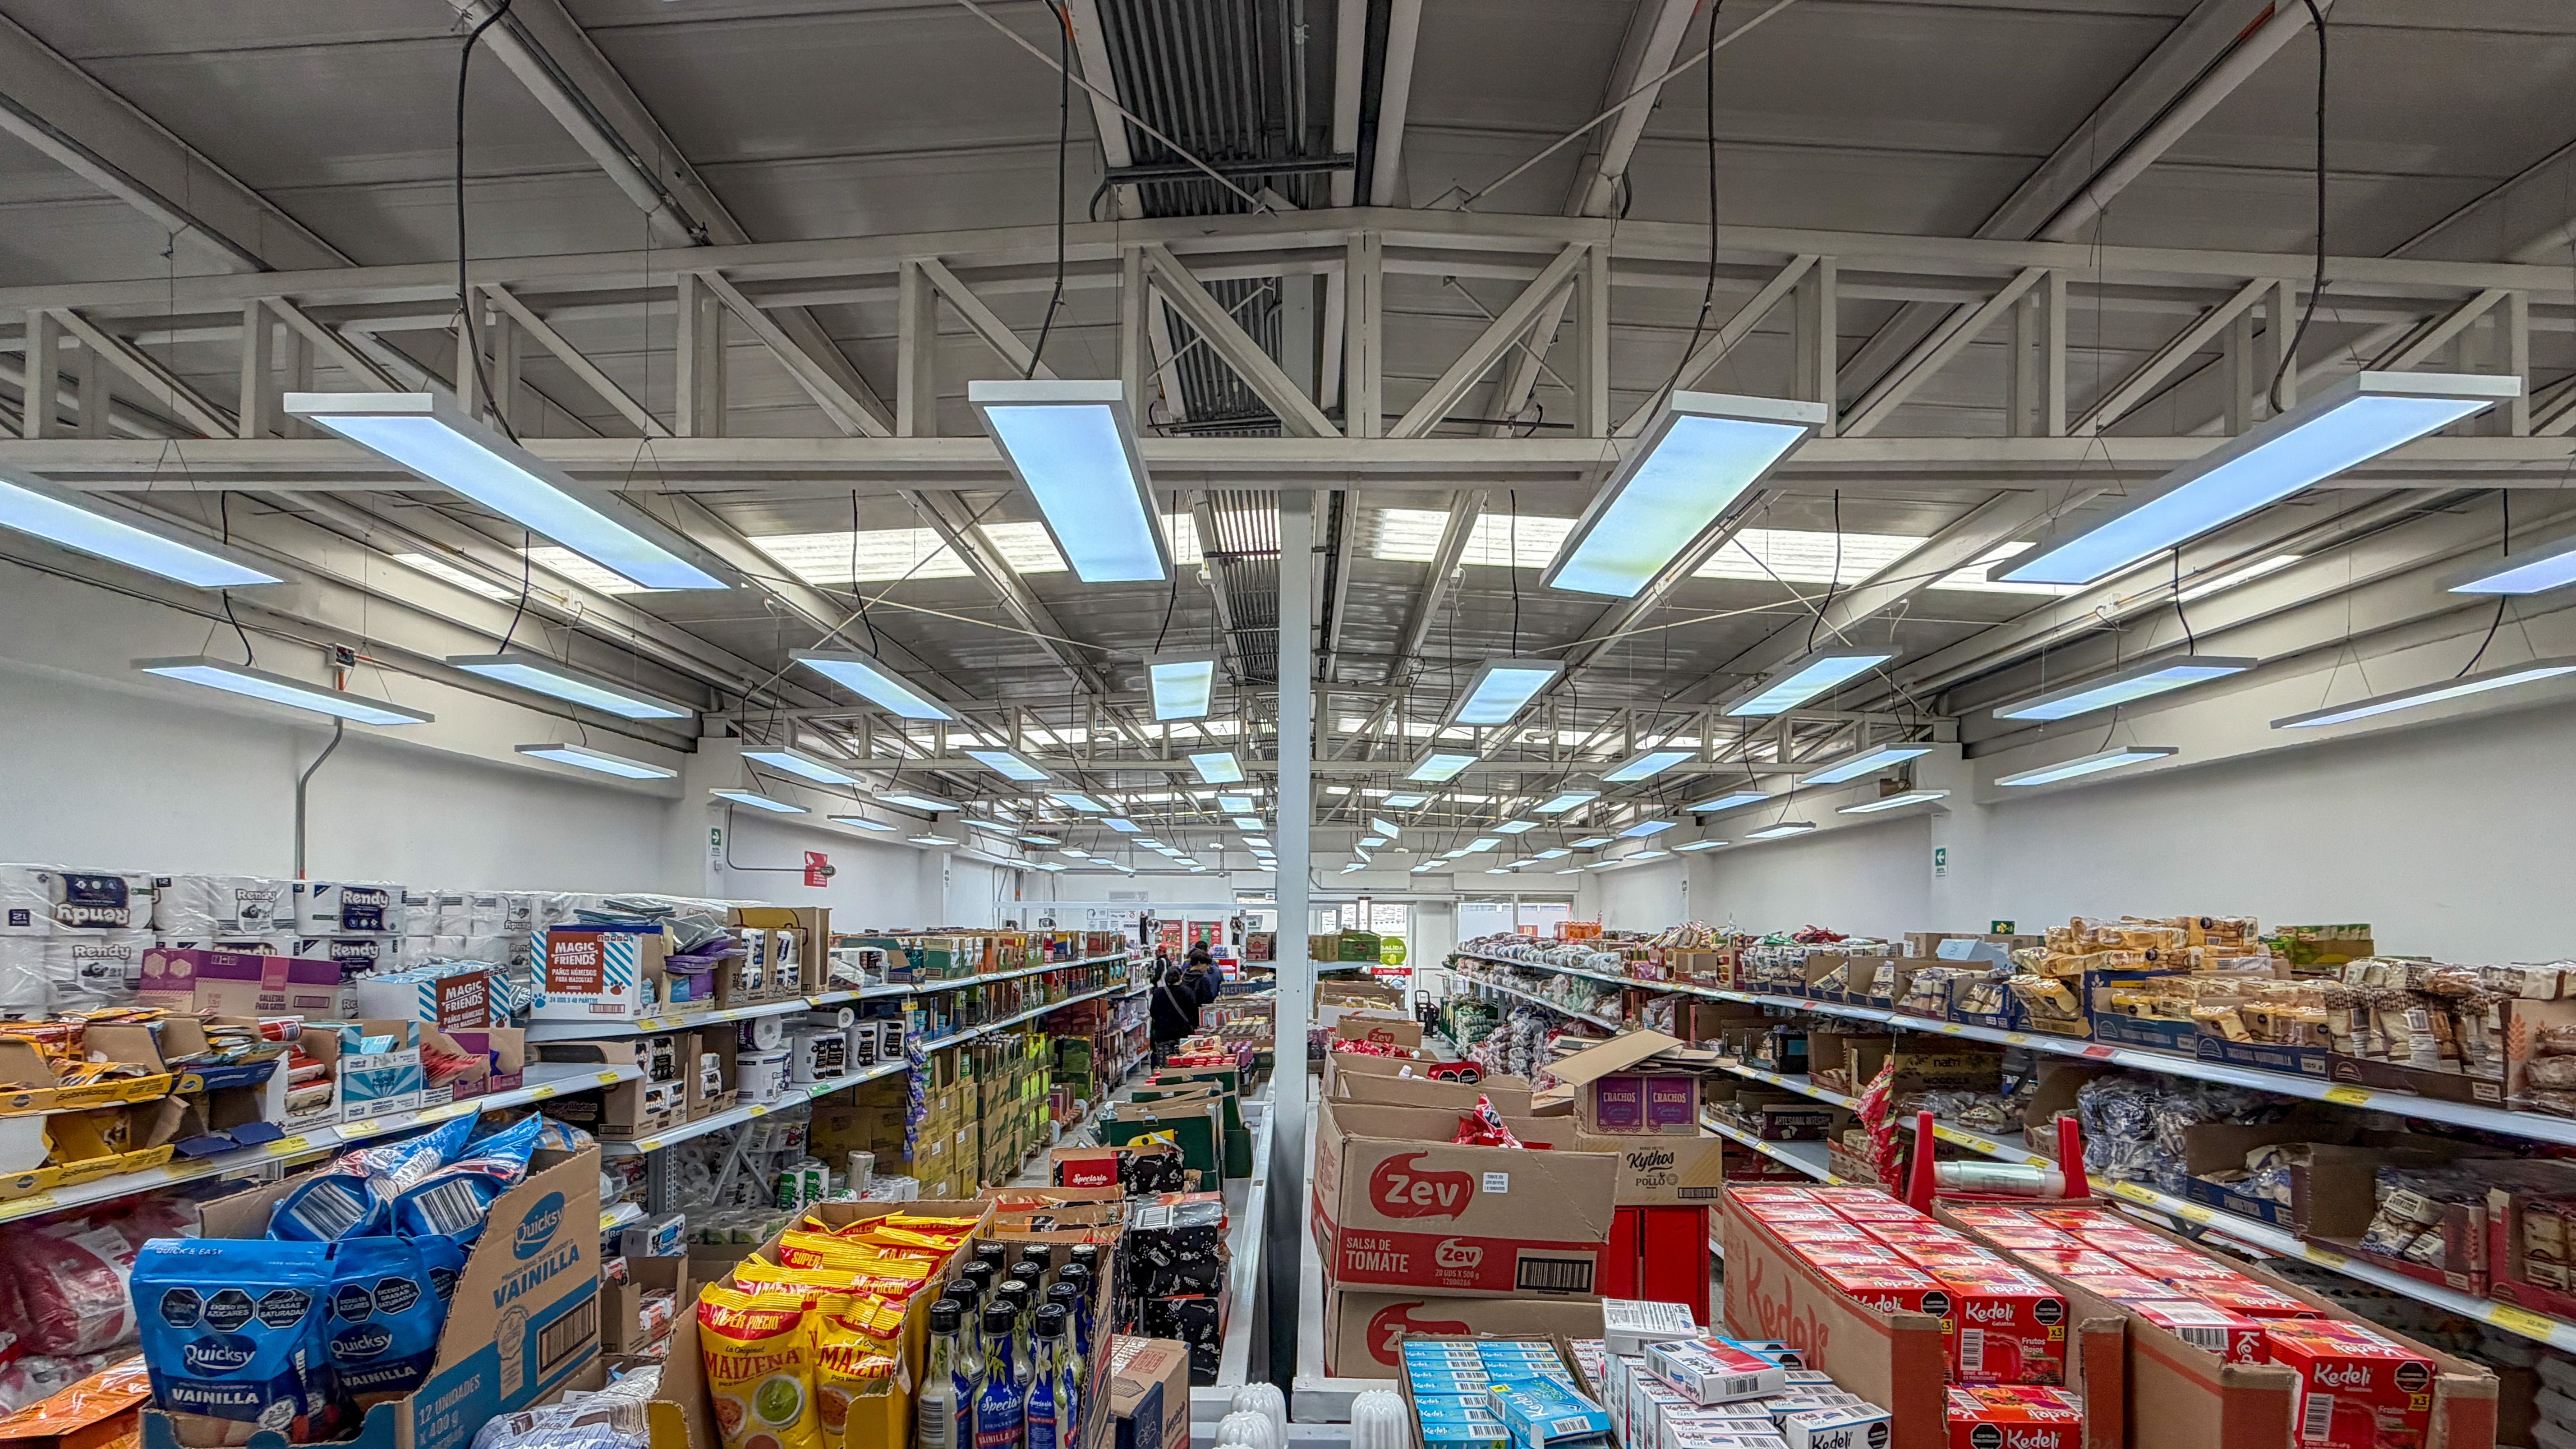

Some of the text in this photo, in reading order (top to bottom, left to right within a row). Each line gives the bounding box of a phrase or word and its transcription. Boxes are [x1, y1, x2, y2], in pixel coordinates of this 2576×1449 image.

[235, 888, 277, 902] Rendy
[341, 889, 390, 909] Rendy
[55, 902, 130, 925] Rendy
[504, 920, 531, 931] Rendy
[73, 944, 131, 960] Rendy
[330, 941, 380, 959] Rendy
[509, 943, 531, 952] Rend
[555, 942, 595, 953] MAGIC
[554, 954, 596, 965] FRIENDS
[446, 980, 482, 1000] MAGIC
[445, 993, 483, 1012] FRIENDS
[739, 1020, 747, 1045] Rendy
[1603, 1092, 1636, 1103] CRACHOS
[1653, 1092, 1686, 1103] CRACHOS
[1626, 1150, 1674, 1172] Kythos
[1072, 1173, 1108, 1185] Speciaria
[1635, 1177, 1665, 1187] POLLO
[1385, 1174, 1459, 1207] Zev
[515, 1206, 564, 1251] Quicksy
[1346, 1237, 1391, 1251] SALSA DE
[791, 1251, 820, 1267] SÚPER
[1345, 1250, 1410, 1273] TOMATE
[1442, 1247, 1477, 1262] Zev
[493, 1244, 580, 1309] VAINILLA
[381, 1289, 410, 1301] GRASAS
[1985, 1284, 2042, 1295] Kedeli
[260, 1309, 306, 1318] SATURADAS
[1966, 1300, 2016, 1323] Kedeli
[2051, 1328, 2062, 1337] x3
[330, 1334, 392, 1359] Quicksy
[735, 1345, 765, 1356] Original
[2022, 1346, 2044, 1355] Rojos
[2330, 1342, 2405, 1357] Kedeli
[184, 1343, 257, 1370] Quicksy
[705, 1349, 801, 1380] MAIZENA
[817, 1343, 895, 1379] MAIZEN
[341, 1366, 417, 1387] VAINILLA
[2314, 1362, 2374, 1388] Kedeli
[172, 1388, 259, 1404] VAINILLA
[418, 1373, 481, 1426] 12 UNIDADES
[2027, 1409, 2084, 1423] Kedeli
[429, 1413, 450, 1438] 400
[1811, 1430, 1854, 1449] Kedeli
[2007, 1428, 2062, 1449] Kedeli
